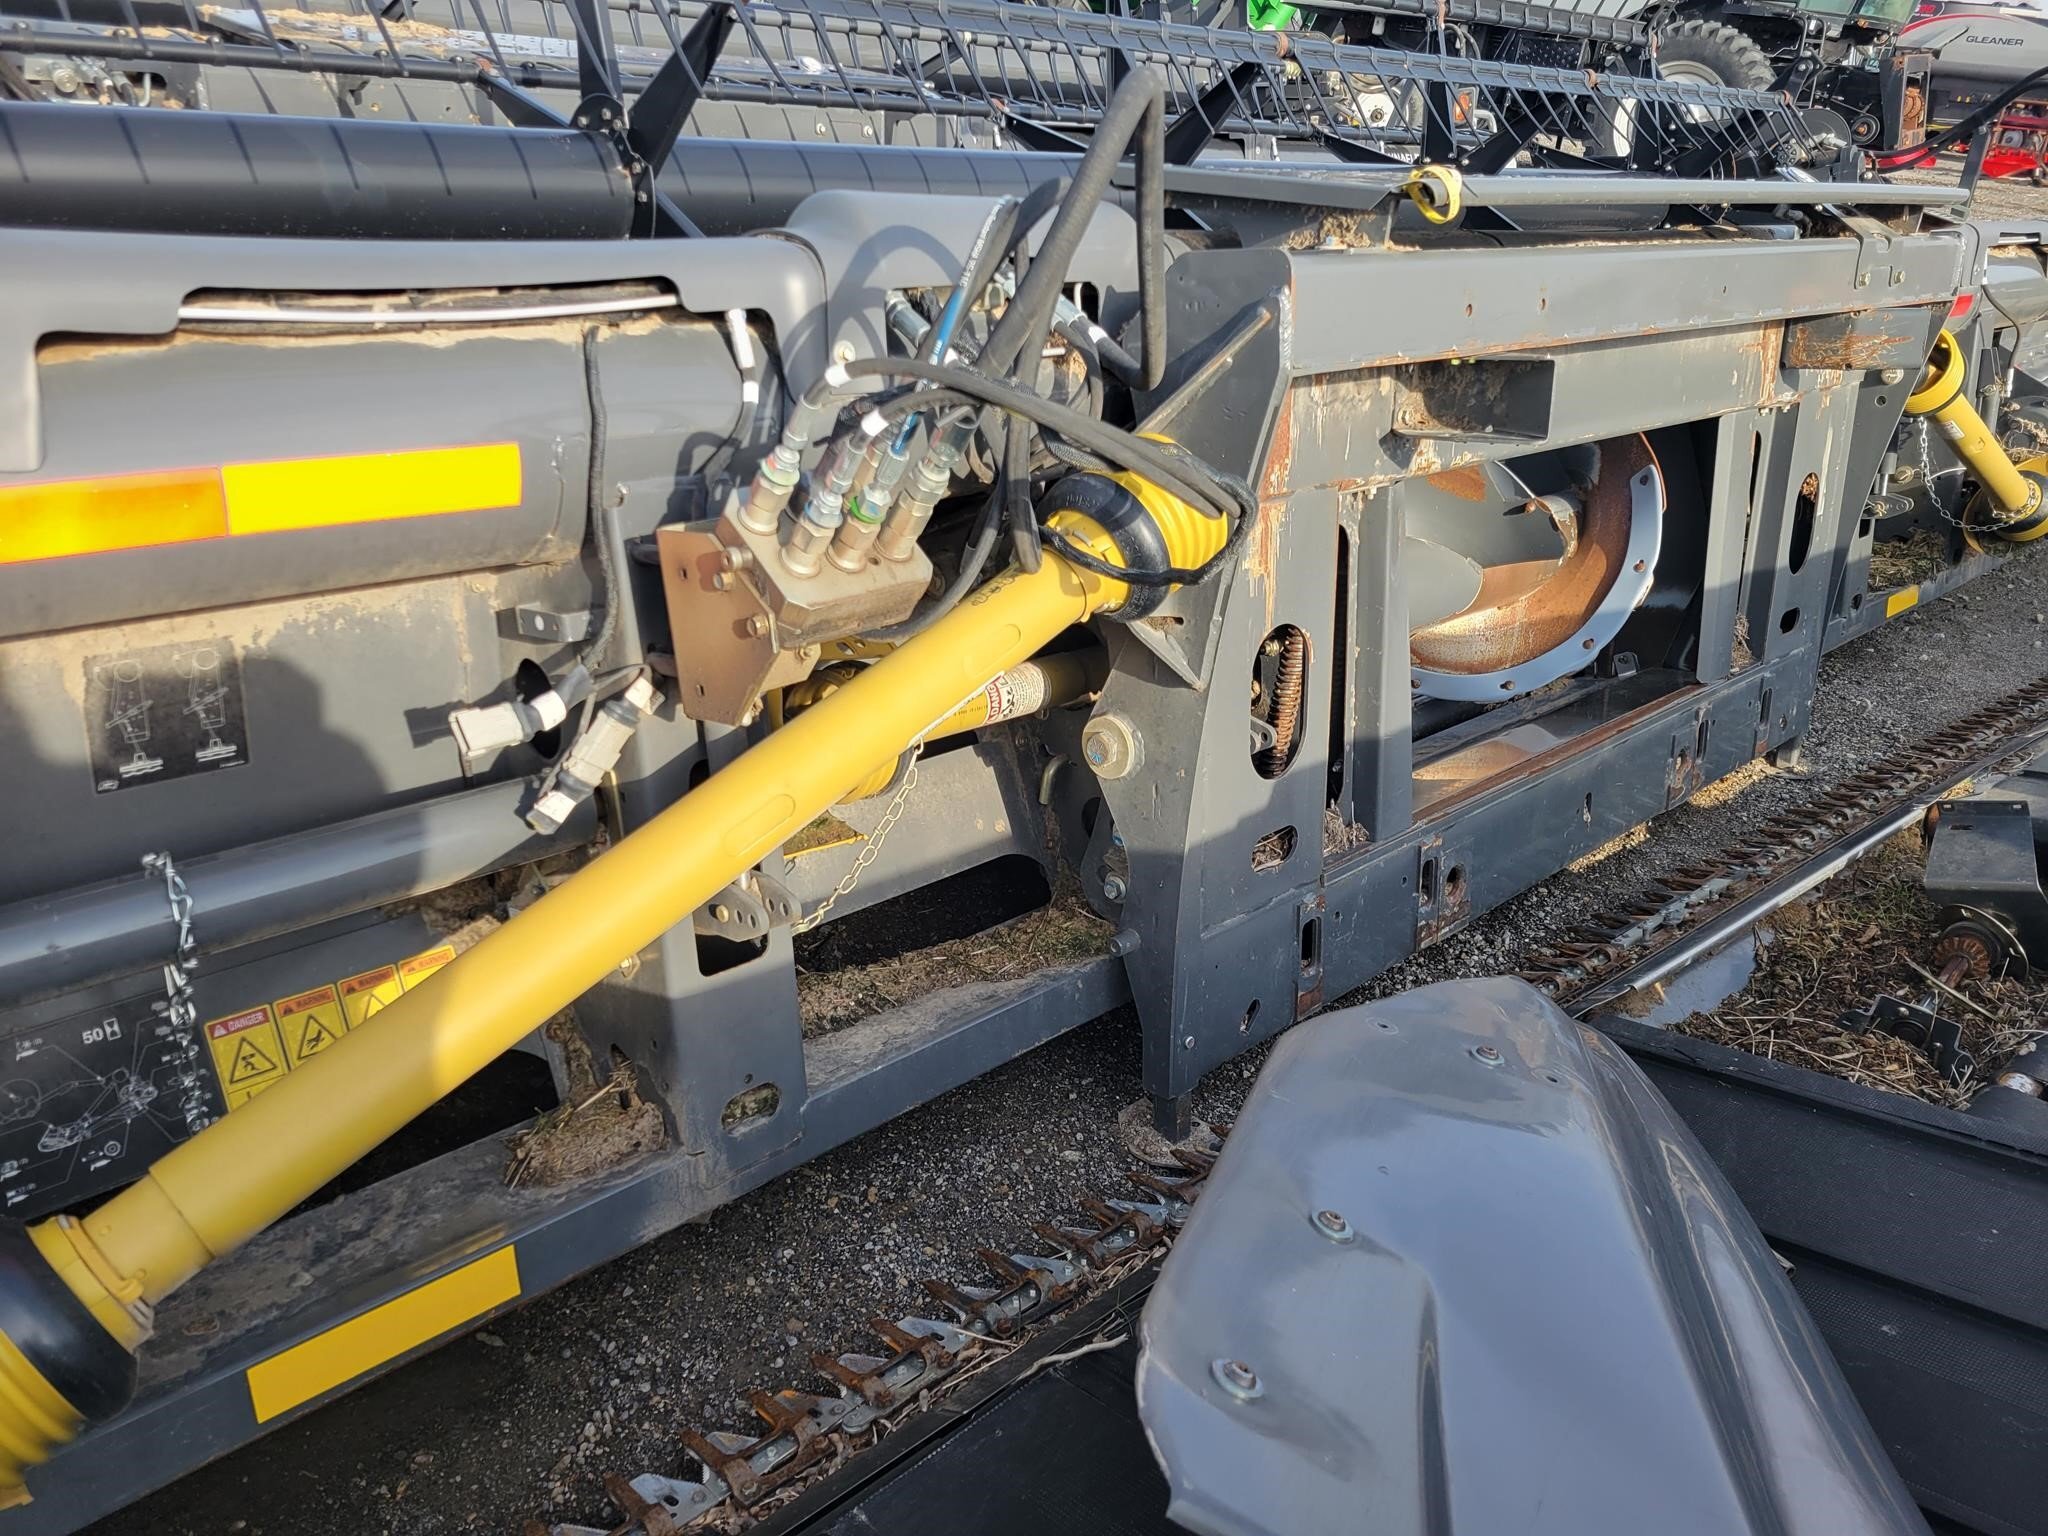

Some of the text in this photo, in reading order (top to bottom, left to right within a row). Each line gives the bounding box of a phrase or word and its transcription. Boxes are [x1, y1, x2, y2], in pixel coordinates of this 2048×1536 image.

[1966, 35, 2024, 47] GLEANER
[227, 1011, 265, 1031] DANGER
[82, 1028, 104, 1044] 50
